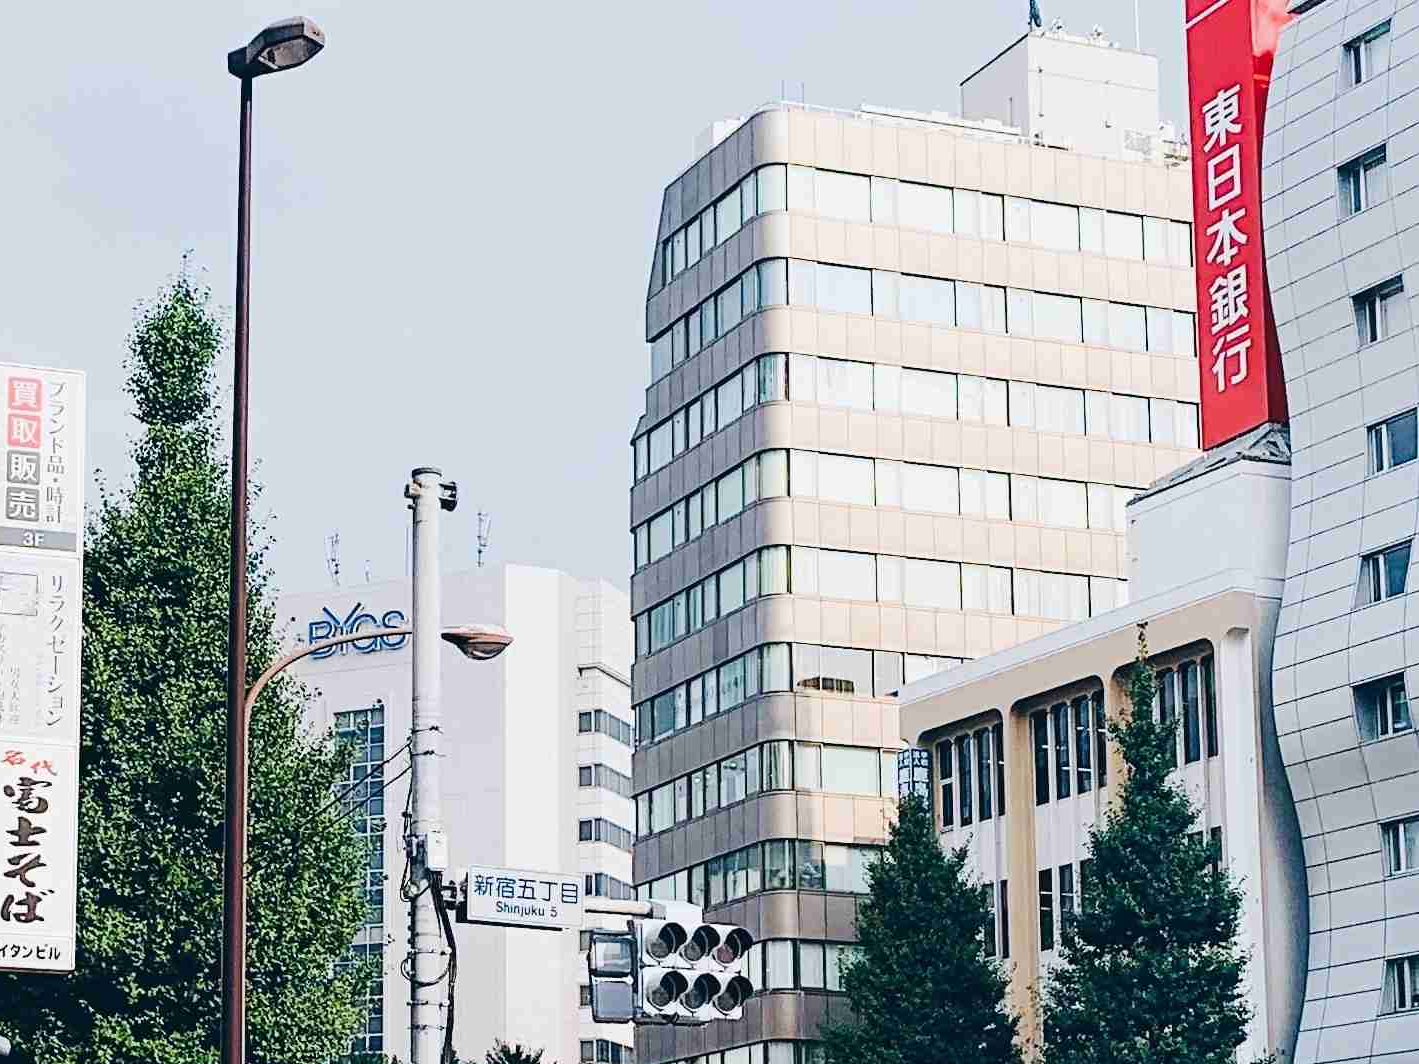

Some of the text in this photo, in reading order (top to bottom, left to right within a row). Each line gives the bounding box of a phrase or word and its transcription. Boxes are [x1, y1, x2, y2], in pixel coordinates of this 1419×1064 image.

[1202, 84, 1253, 393] 東日本銀行
[7, 377, 40, 522] 買取販売
[22, 531, 45, 547] 3F
[0, 776, 55, 924] 富士そば
[474, 875, 578, 905] 新宿五丁目
[496, 901, 558, 918] Shinjuku 5
